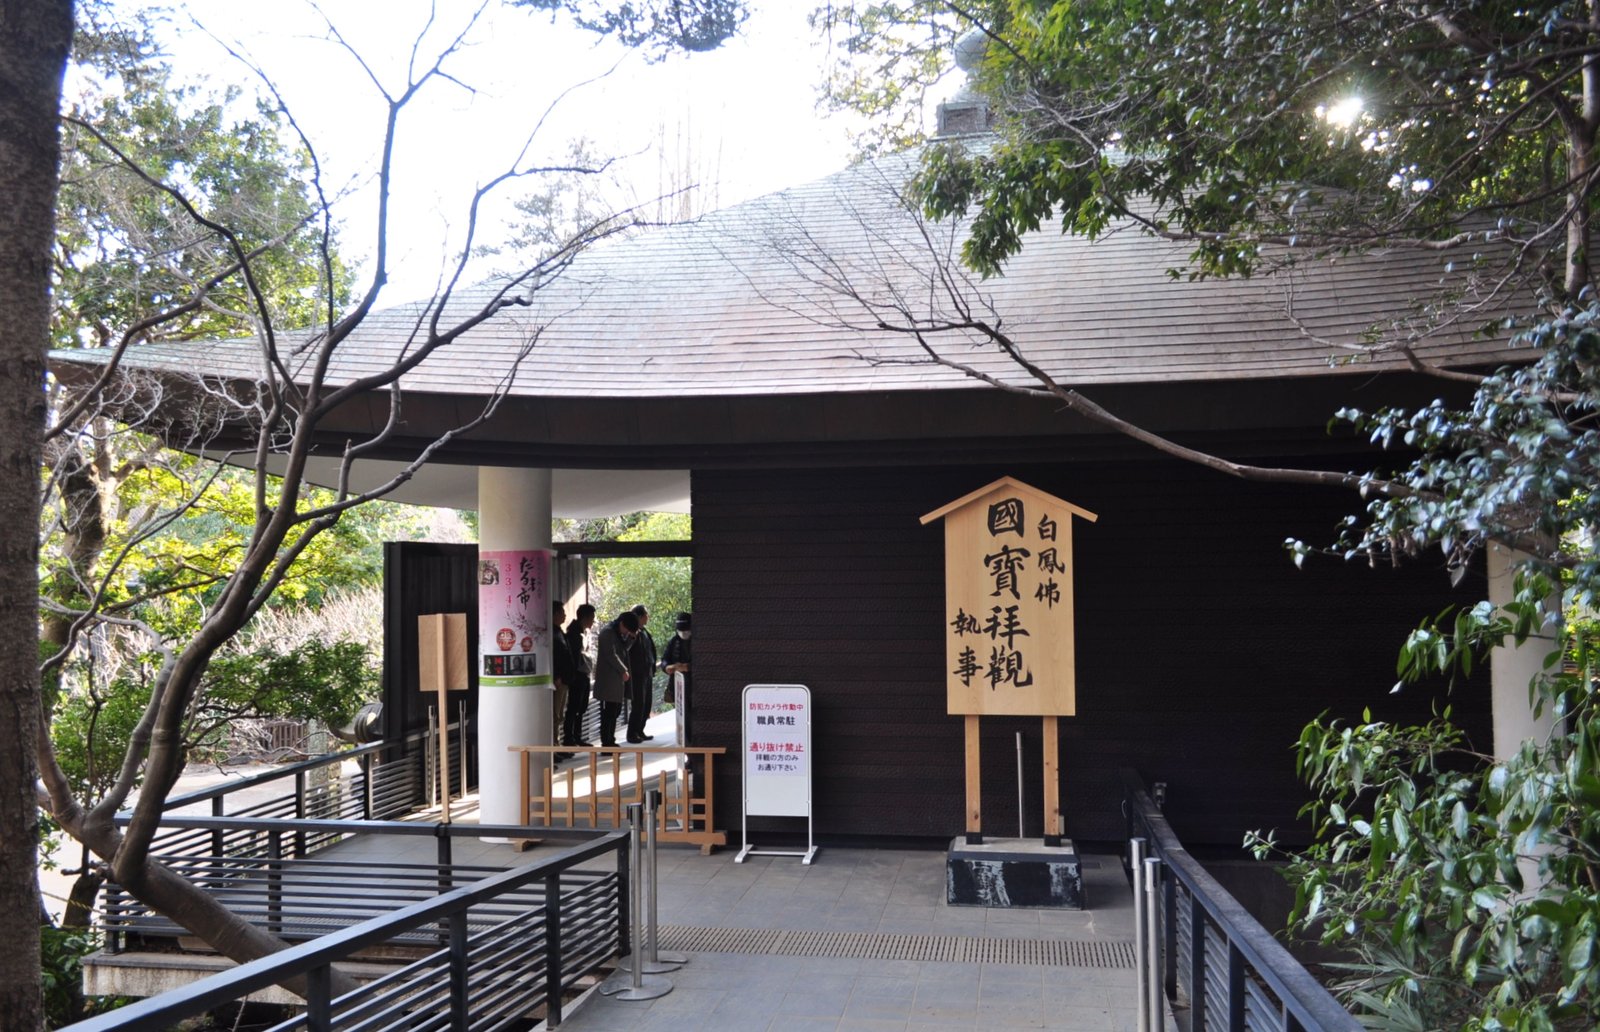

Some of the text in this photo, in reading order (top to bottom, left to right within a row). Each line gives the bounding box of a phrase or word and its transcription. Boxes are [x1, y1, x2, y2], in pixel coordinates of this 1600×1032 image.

[950, 608, 984, 688] 執事
[749, 703, 804, 711] 防犯カメラ作動中
[757, 715, 796, 726] 職員常駐
[749, 742, 804, 752] 通り抜け禁止
[757, 763, 797, 771] お通り下さい
